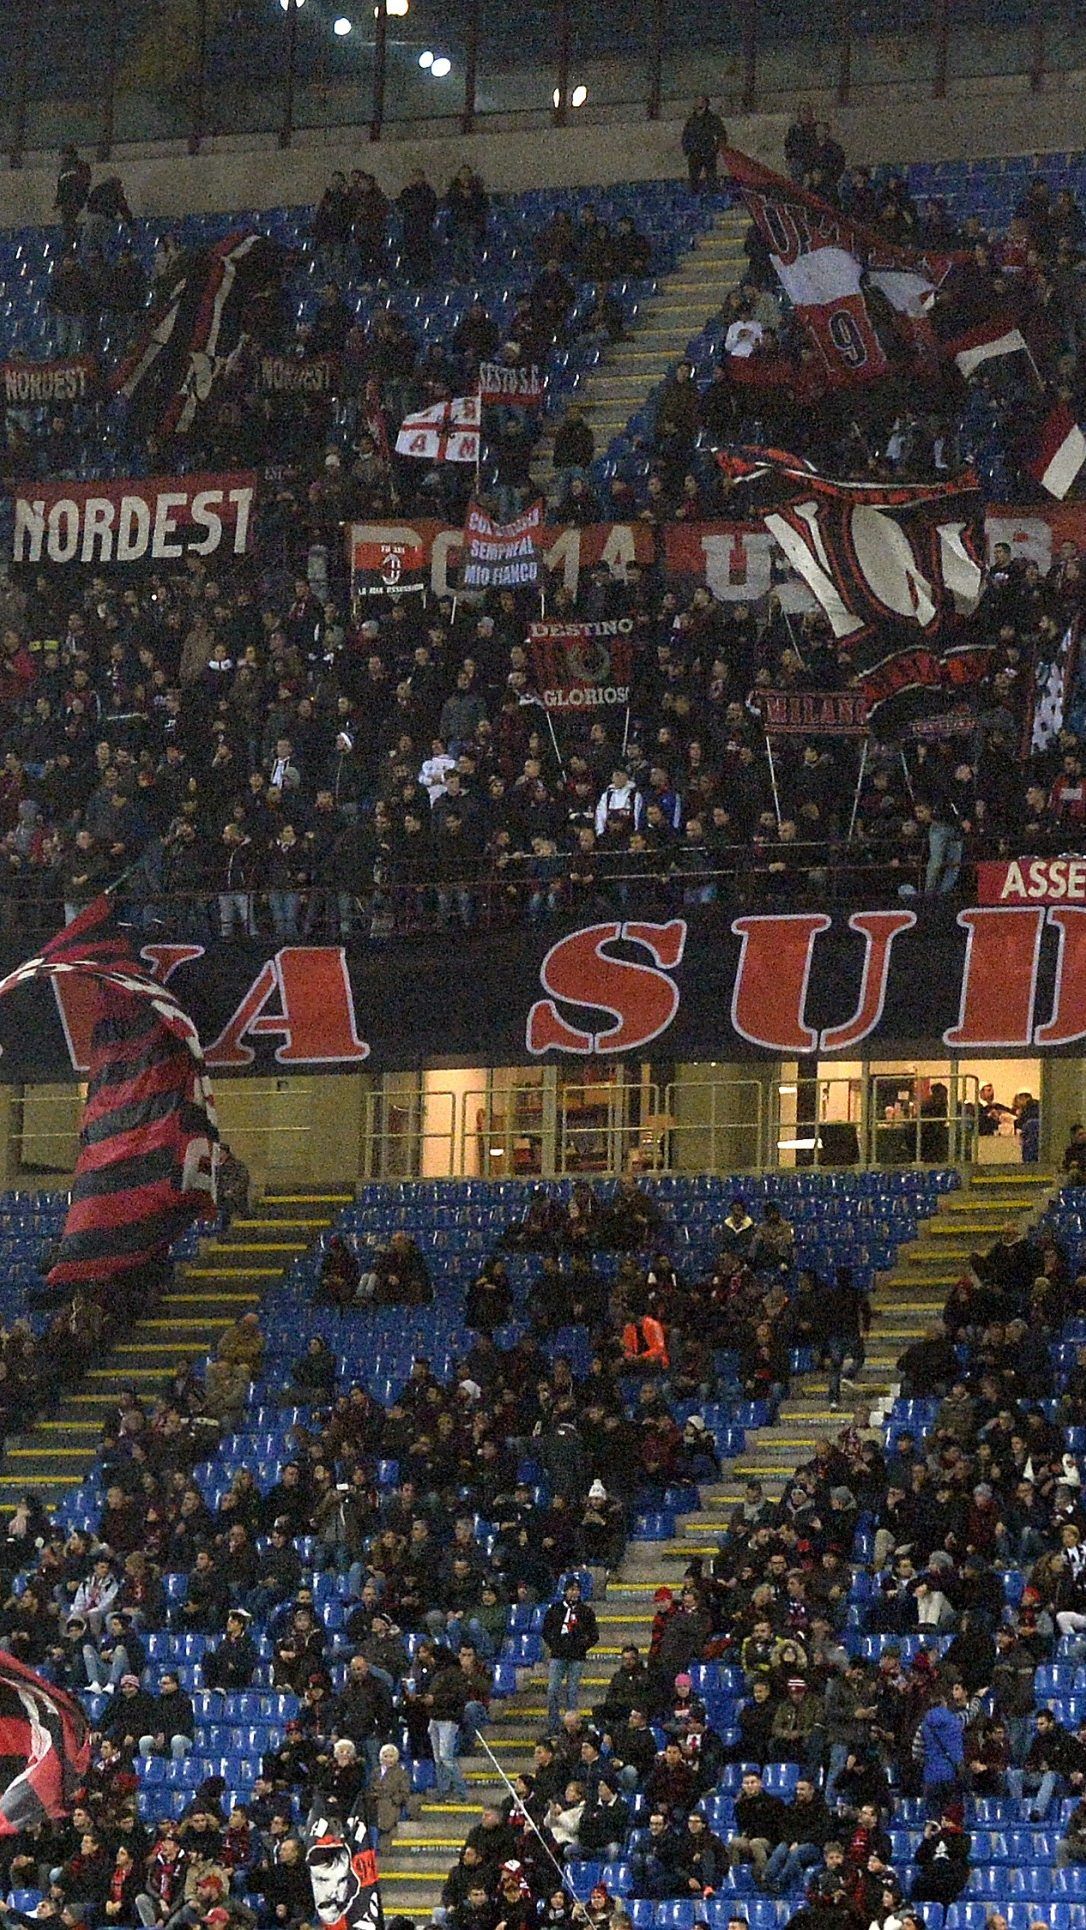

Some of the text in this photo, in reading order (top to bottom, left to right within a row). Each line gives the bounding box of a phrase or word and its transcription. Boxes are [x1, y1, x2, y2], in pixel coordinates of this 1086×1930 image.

[13, 487, 253, 563] NORDEST
[464, 562, 538, 586] MIO FIANCO
[531, 618, 633, 638] DESTINO
[1001, 861, 1086, 899] ASSE
